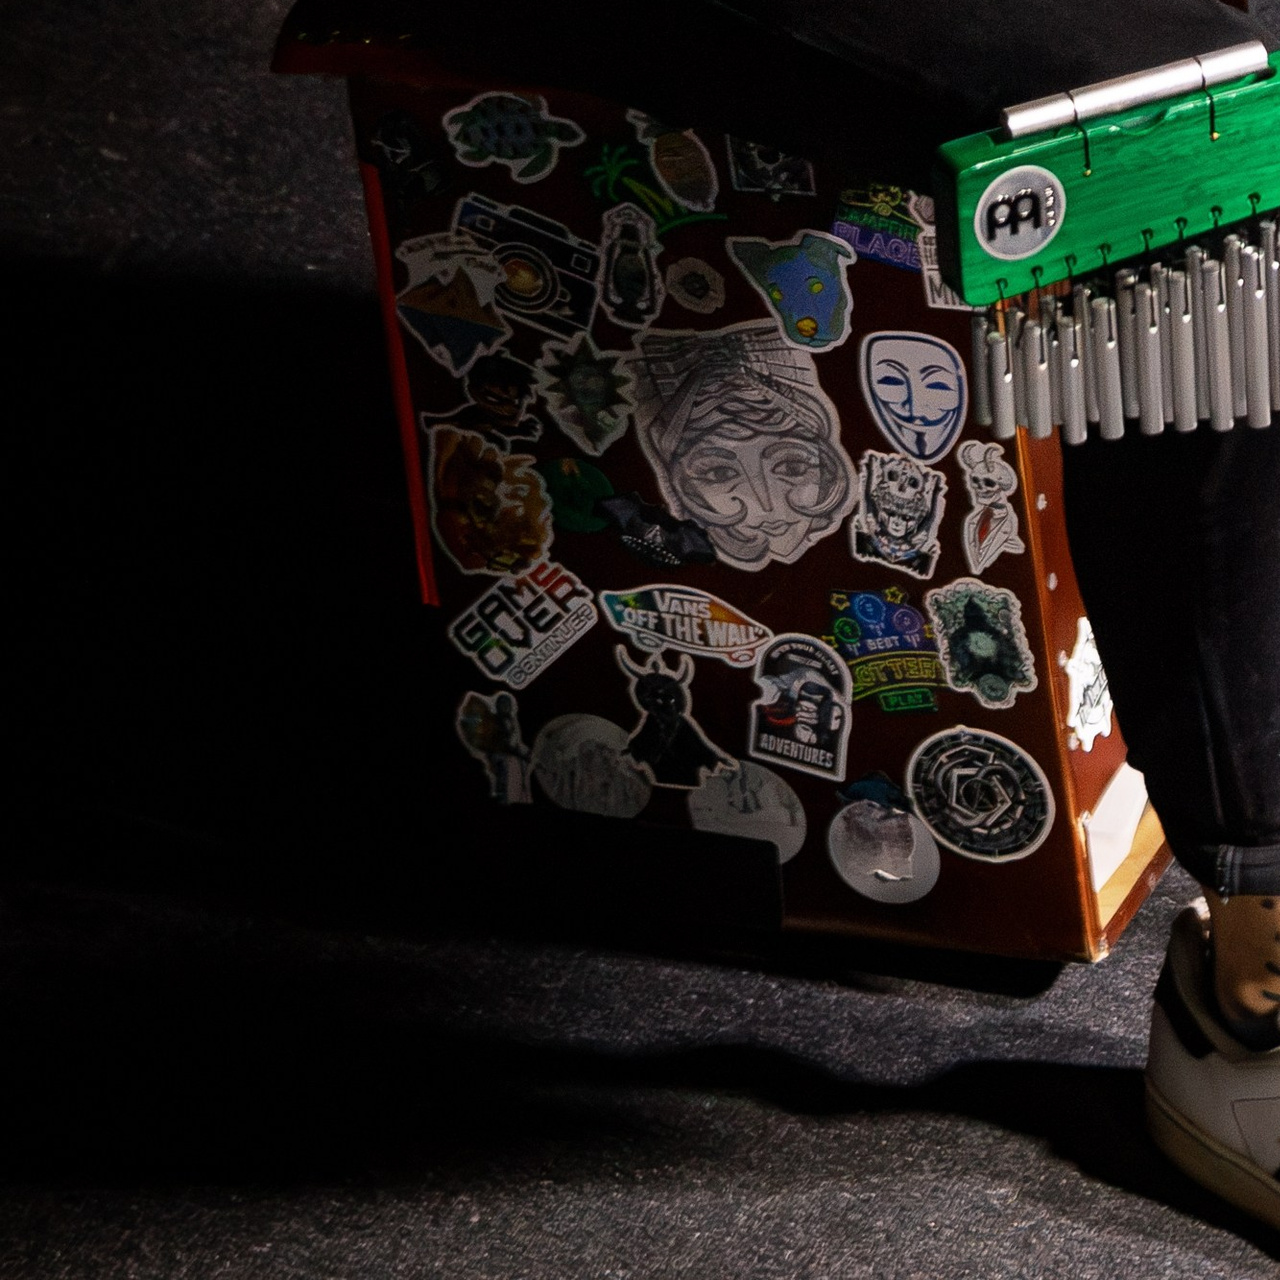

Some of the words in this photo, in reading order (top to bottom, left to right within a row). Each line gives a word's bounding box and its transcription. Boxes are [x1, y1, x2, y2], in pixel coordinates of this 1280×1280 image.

[454, 562, 562, 652] GAME
[652, 590, 713, 619] VANS
[478, 575, 589, 675] OVER
[660, 612, 705, 646] THE
[758, 732, 836, 769] ADVENTURES
